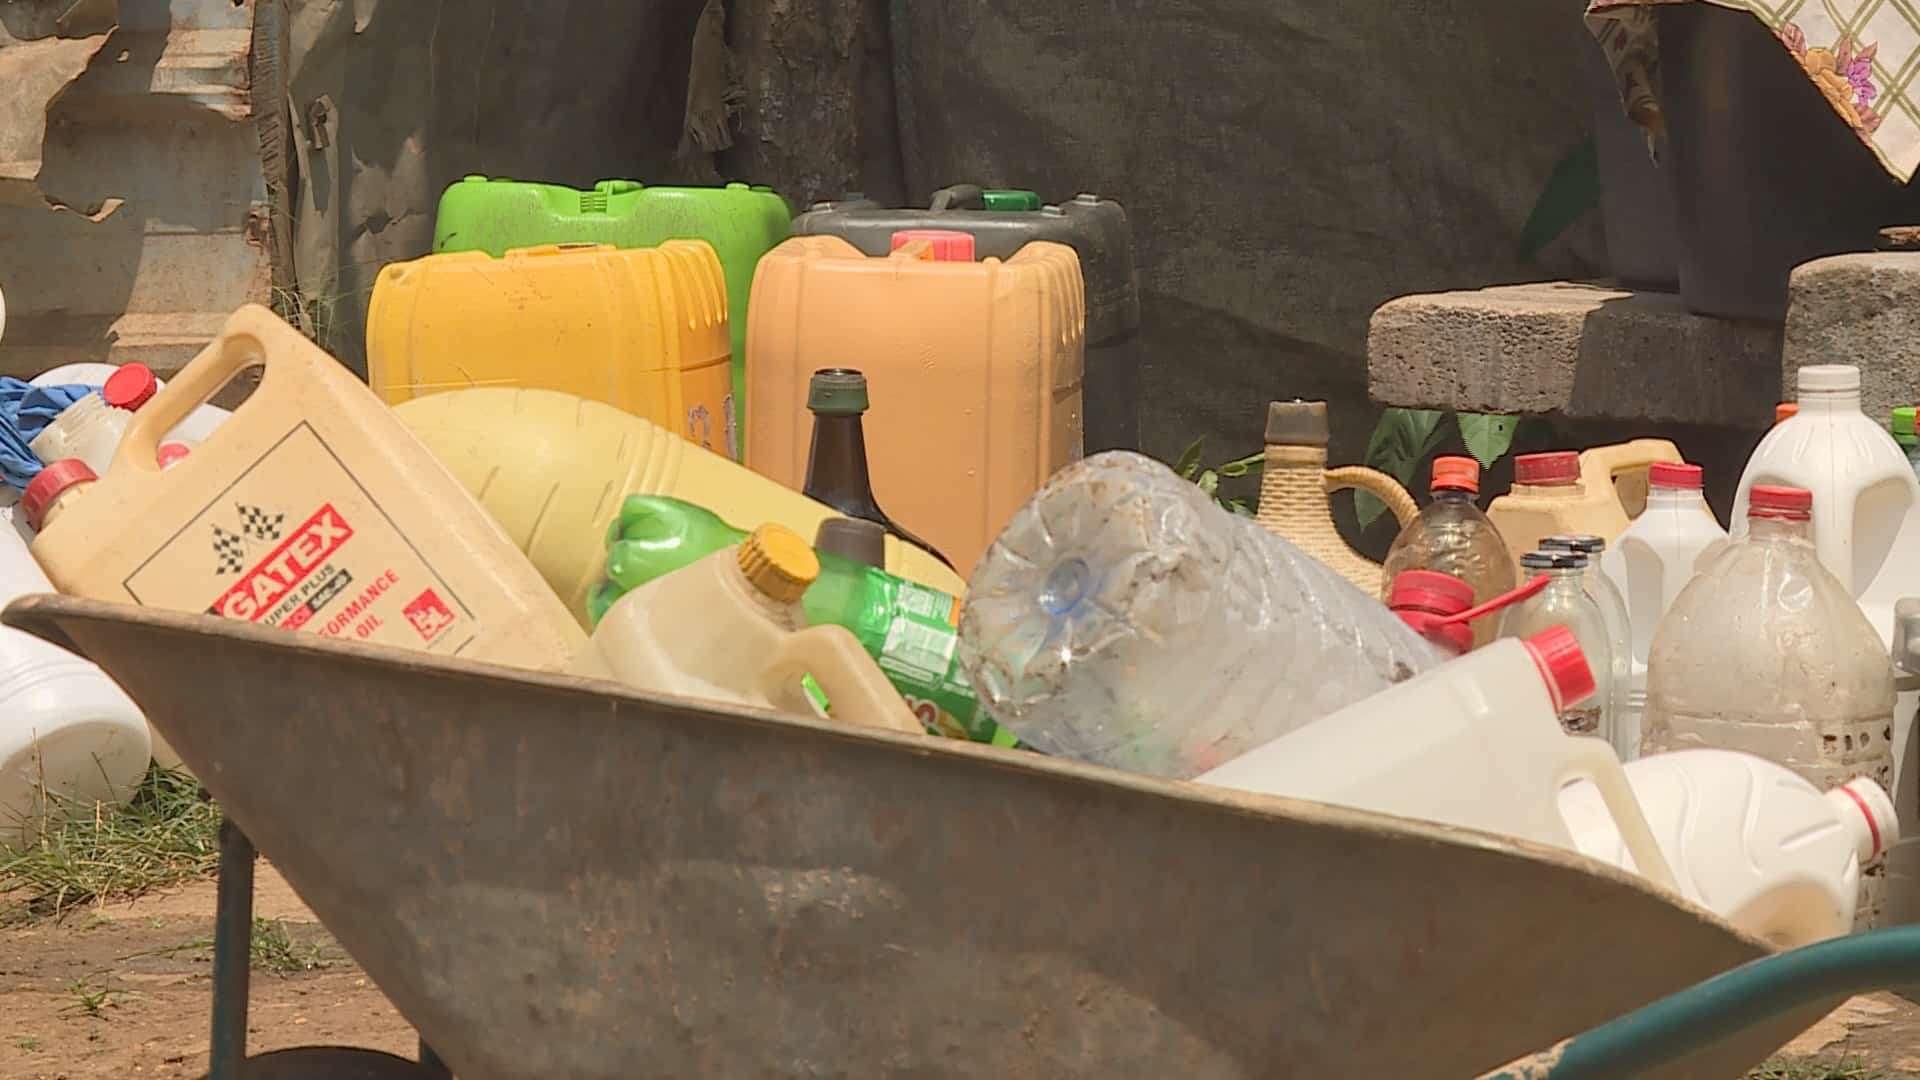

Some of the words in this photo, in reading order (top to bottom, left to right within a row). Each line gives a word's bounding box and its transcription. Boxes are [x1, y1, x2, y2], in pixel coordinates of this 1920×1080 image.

[223, 511, 347, 618] GATEX
[264, 594, 301, 626] UPER
[301, 563, 335, 596] PLUS
[318, 568, 399, 639] FORMANCE
[356, 614, 384, 638] OIL
